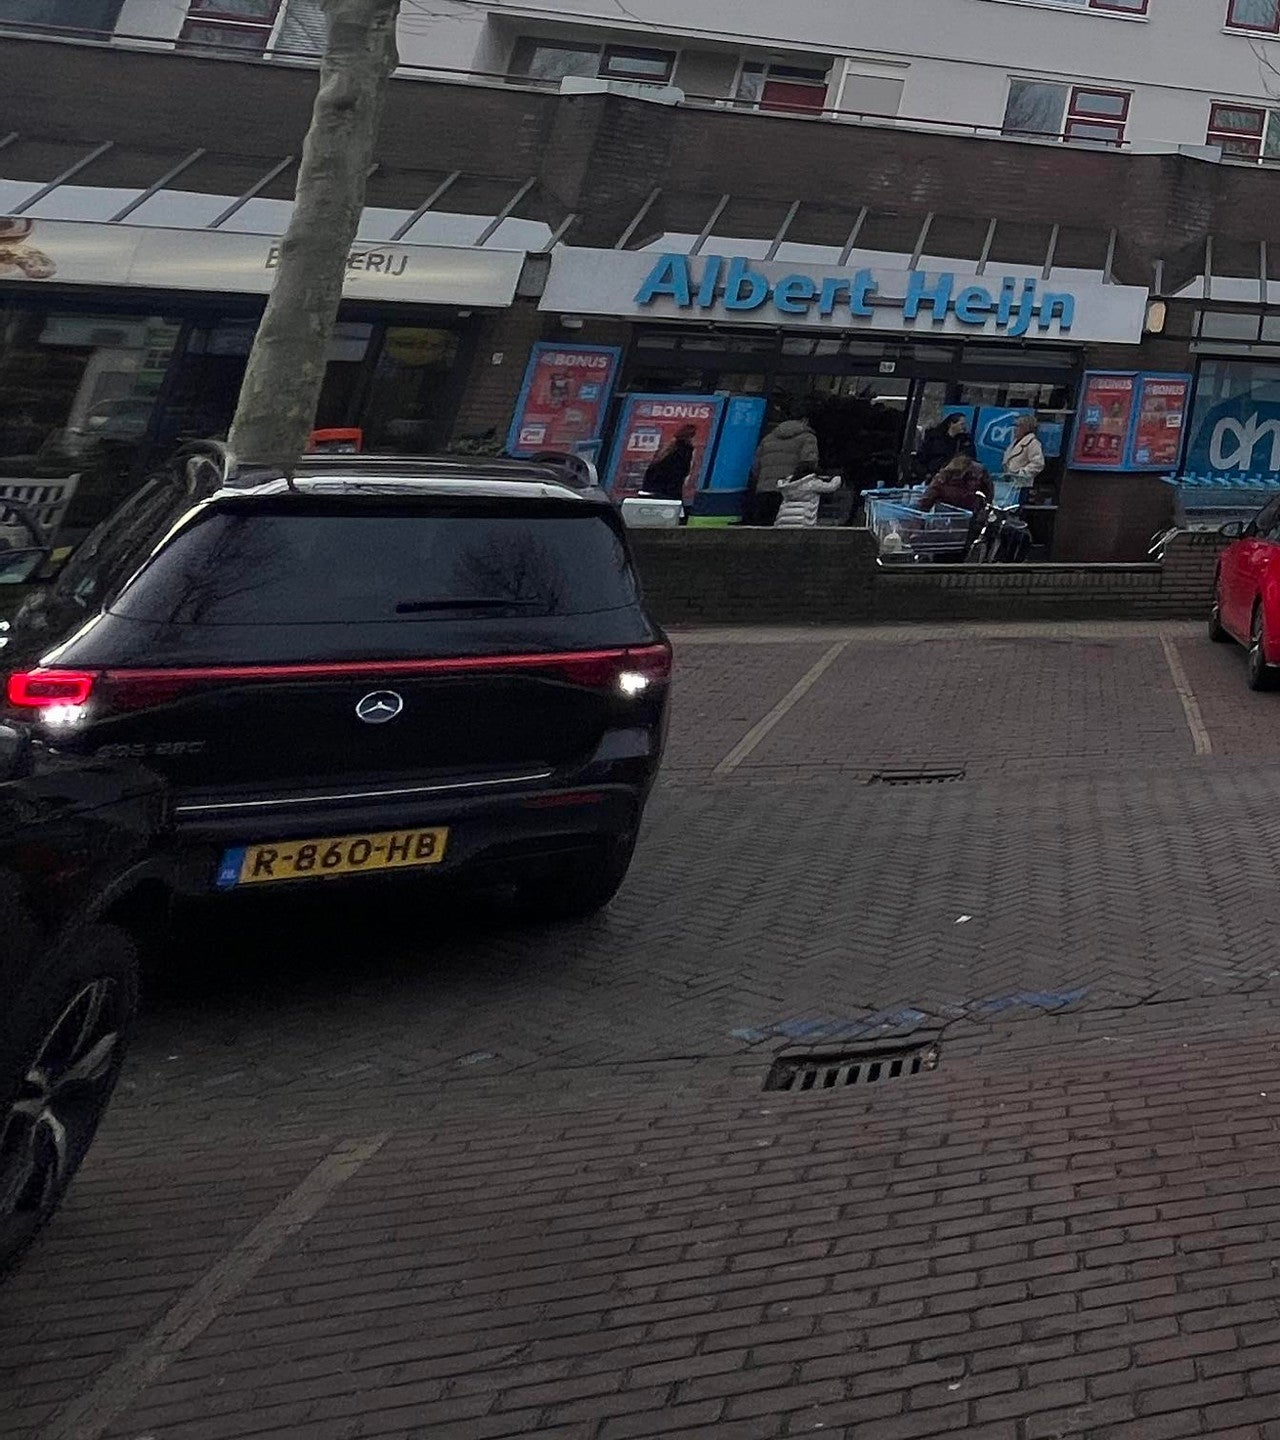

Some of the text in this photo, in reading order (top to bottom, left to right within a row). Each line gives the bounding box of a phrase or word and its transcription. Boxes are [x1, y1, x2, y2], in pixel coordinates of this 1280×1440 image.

[265, 246, 409, 276] BERIJ
[633, 252, 1075, 337] Albert Heijn
[554, 353, 608, 368] BONUS
[650, 404, 711, 419] BONUS
[251, 830, 438, 878] R-860-HB
